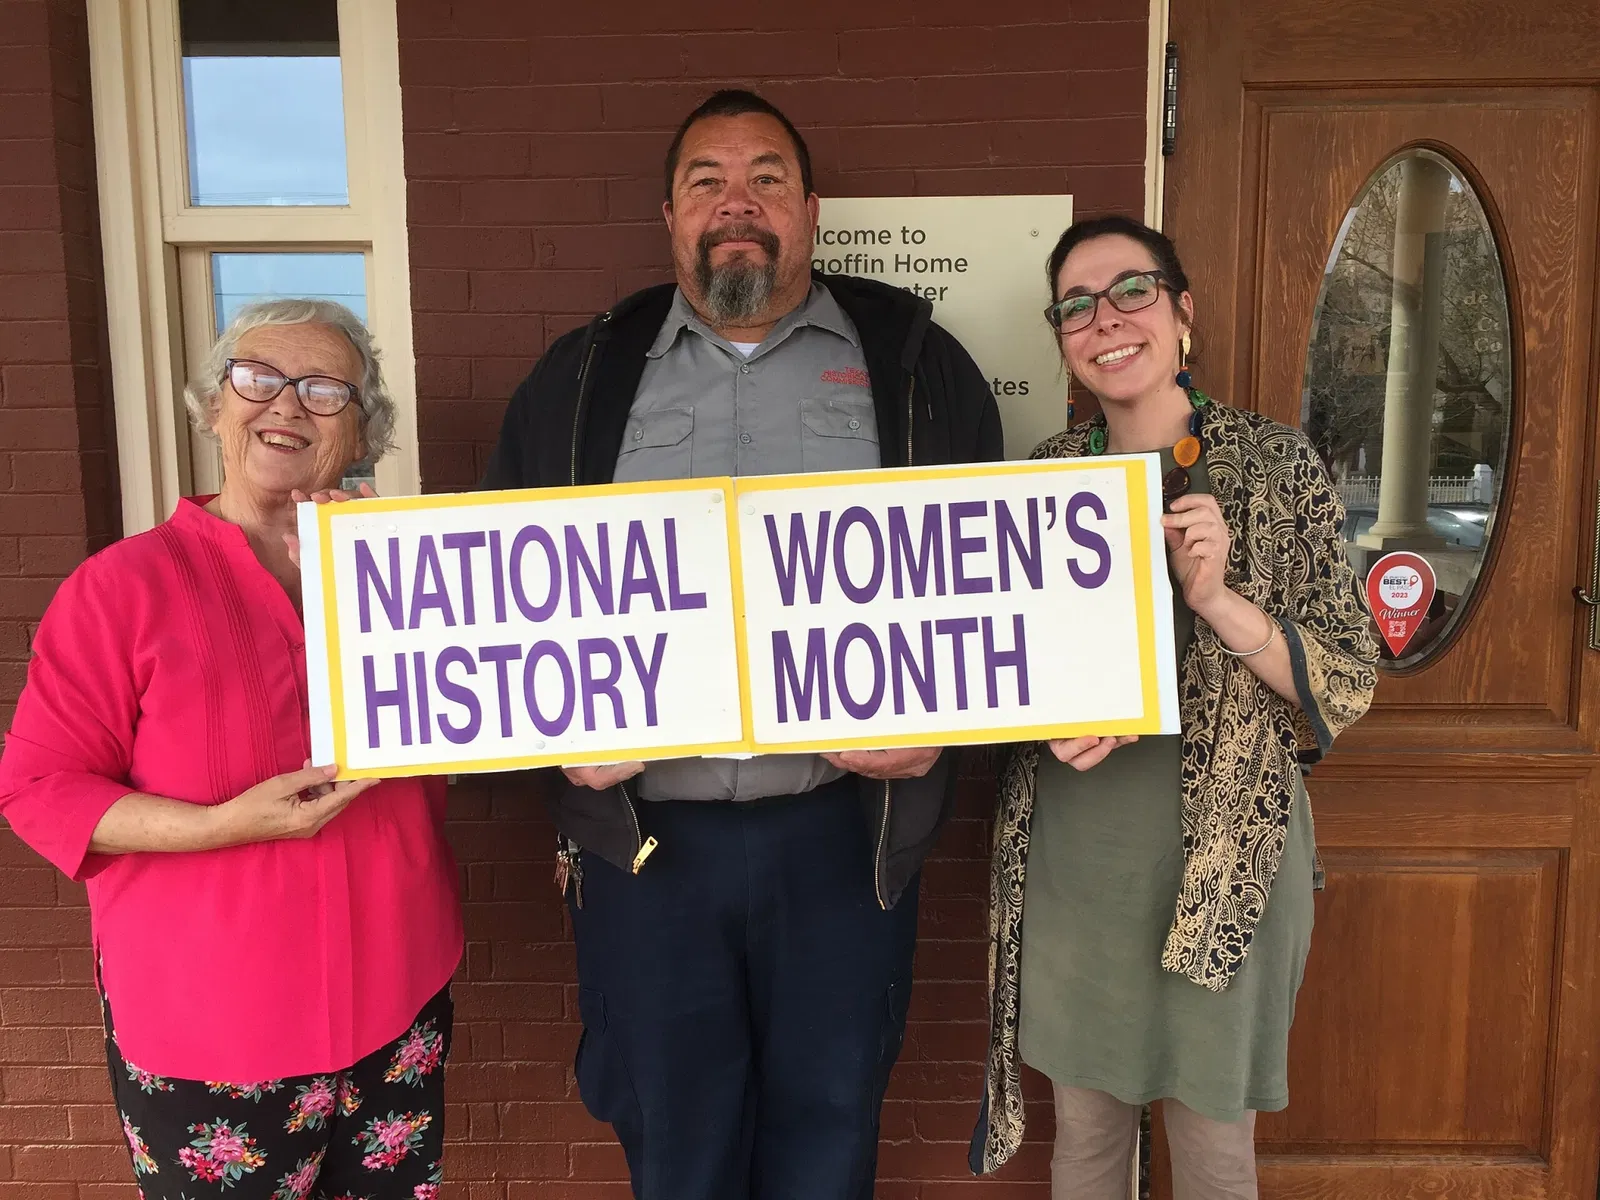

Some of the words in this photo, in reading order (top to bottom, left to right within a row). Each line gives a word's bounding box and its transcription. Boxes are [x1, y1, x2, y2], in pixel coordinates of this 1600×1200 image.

[816, 225, 892, 246] lcome
[901, 226, 926, 245] to
[811, 253, 885, 274] goffin
[894, 254, 969, 274] Home
[902, 283, 949, 302] ter
[992, 377, 1029, 396] tes
[354, 517, 708, 634] NATIONAL
[763, 491, 1112, 607] WOMEN'S
[1379, 608, 1421, 620] Winner
[362, 633, 669, 749] HISTORY
[771, 614, 1030, 724] MONTH
